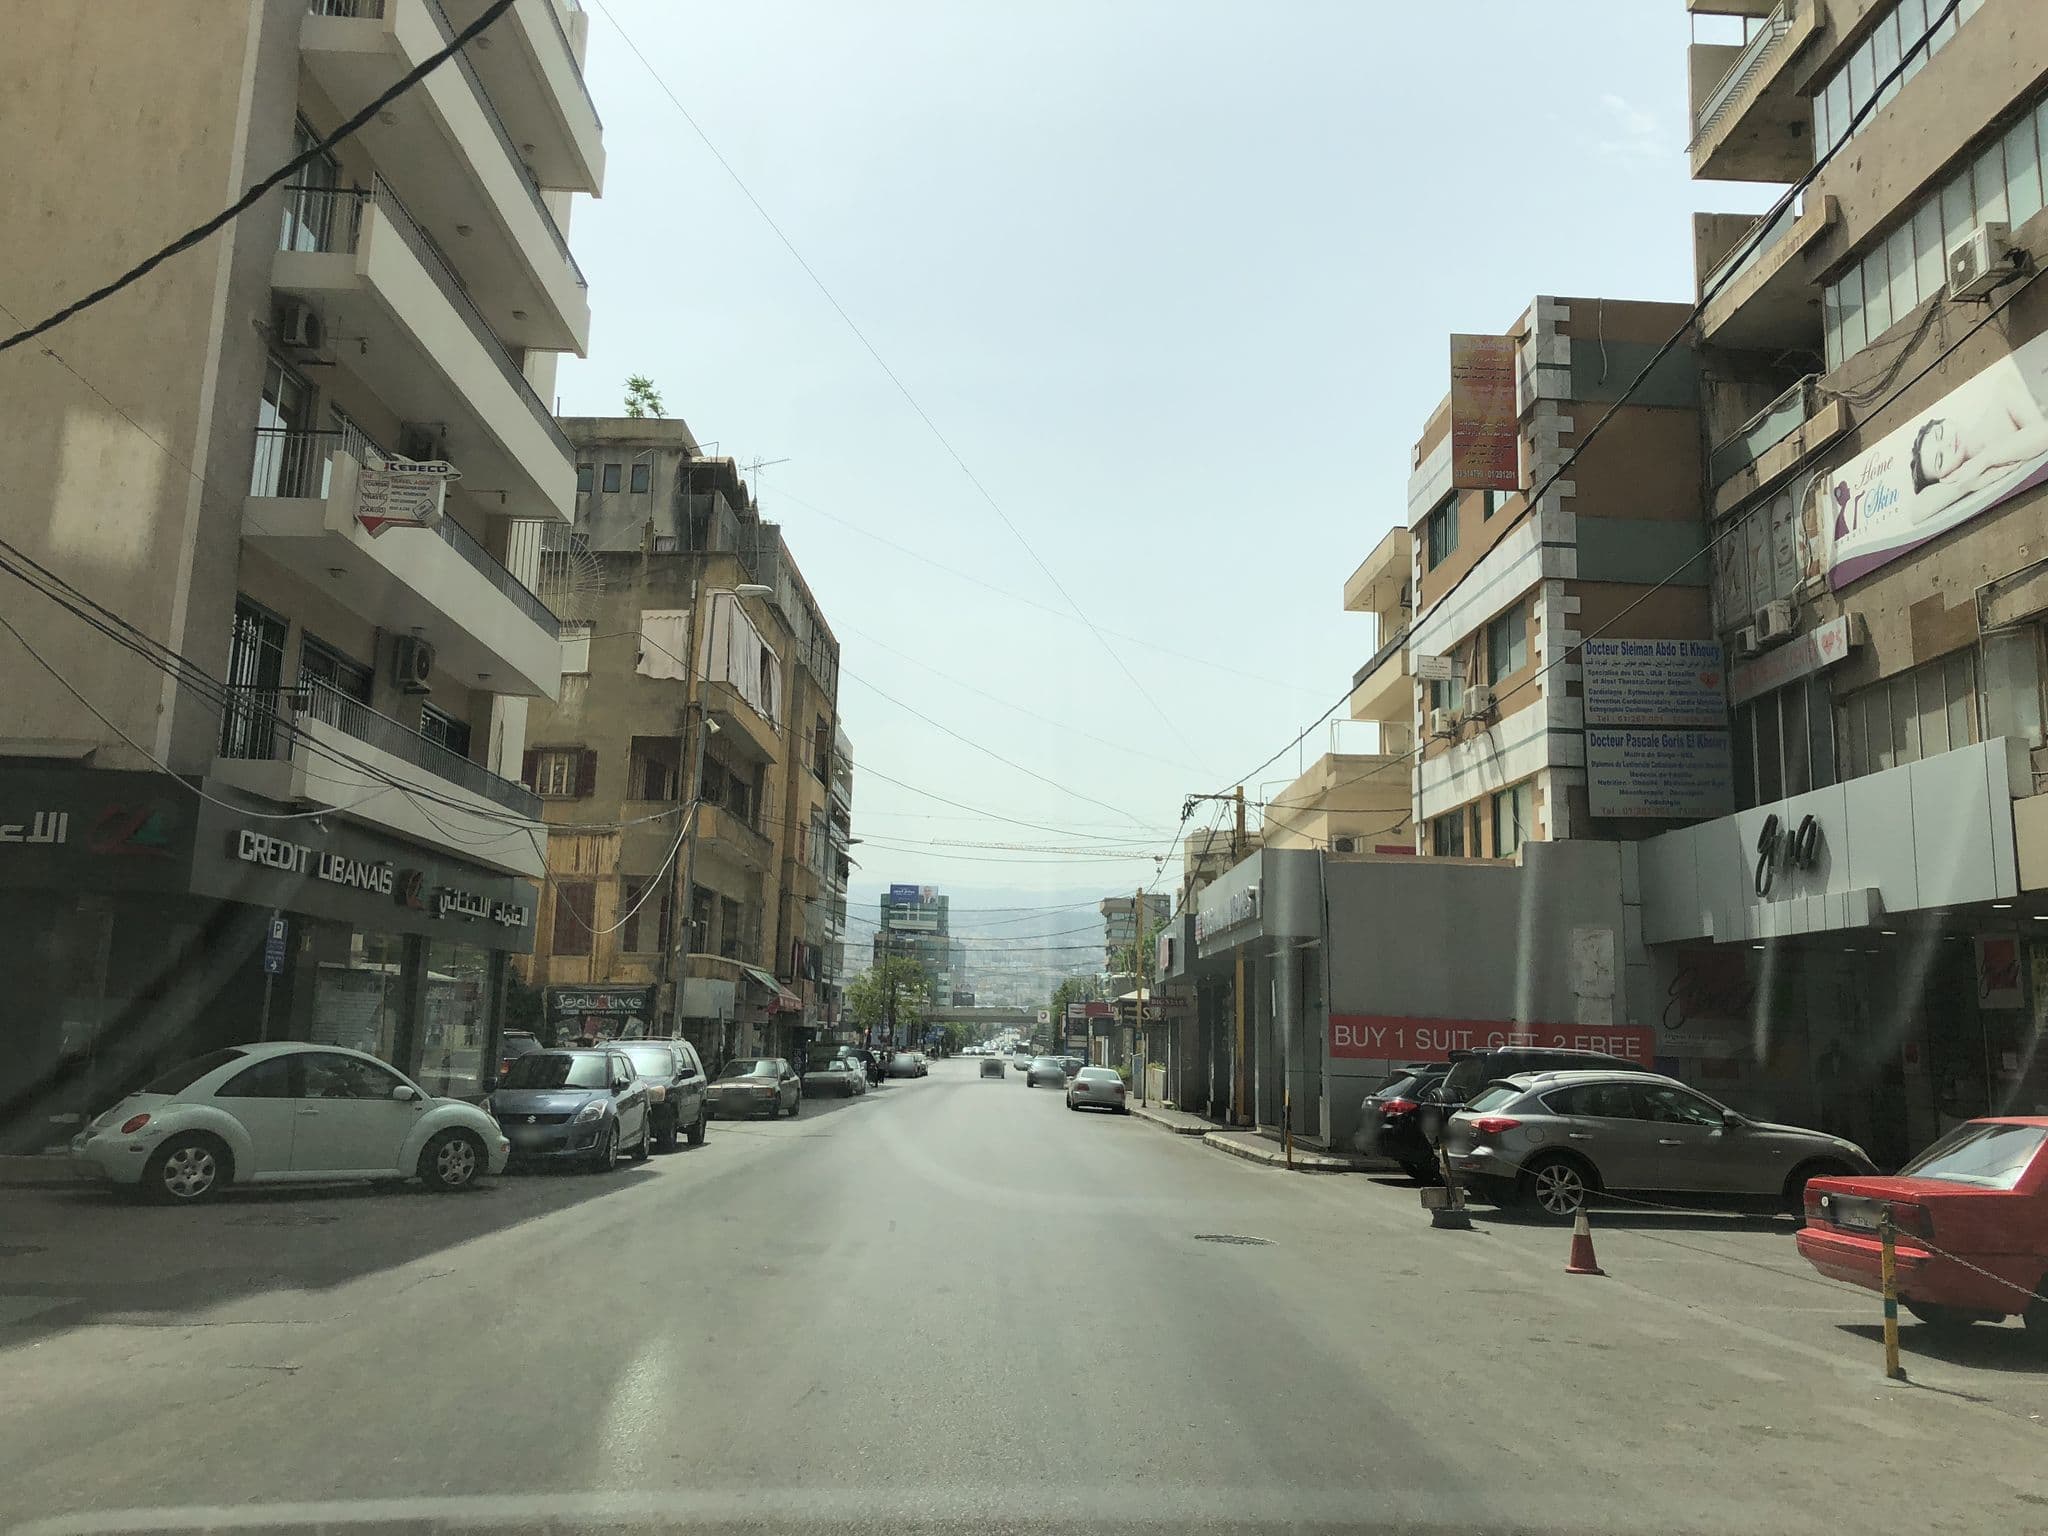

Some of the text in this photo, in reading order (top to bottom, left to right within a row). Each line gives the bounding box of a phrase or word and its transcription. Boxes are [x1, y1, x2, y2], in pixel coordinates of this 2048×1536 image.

[1586, 641, 1720, 660] Docteur Sleiman Abdo El Khoury
[1590, 733, 1624, 748] Docteur
[1626, 733, 1660, 748] Pascale
[238, 829, 394, 896] CREDIT LIBANAIS
[439, 886, 530, 928] الاعتماد اللبناني
[1333, 1024, 1388, 1048] BUY
[1394, 1027, 1405, 1048] 1
[1415, 1028, 1473, 1051] SUIT
[1487, 1030, 1539, 1048] GET
[1573, 1035, 1641, 1058] FREE
